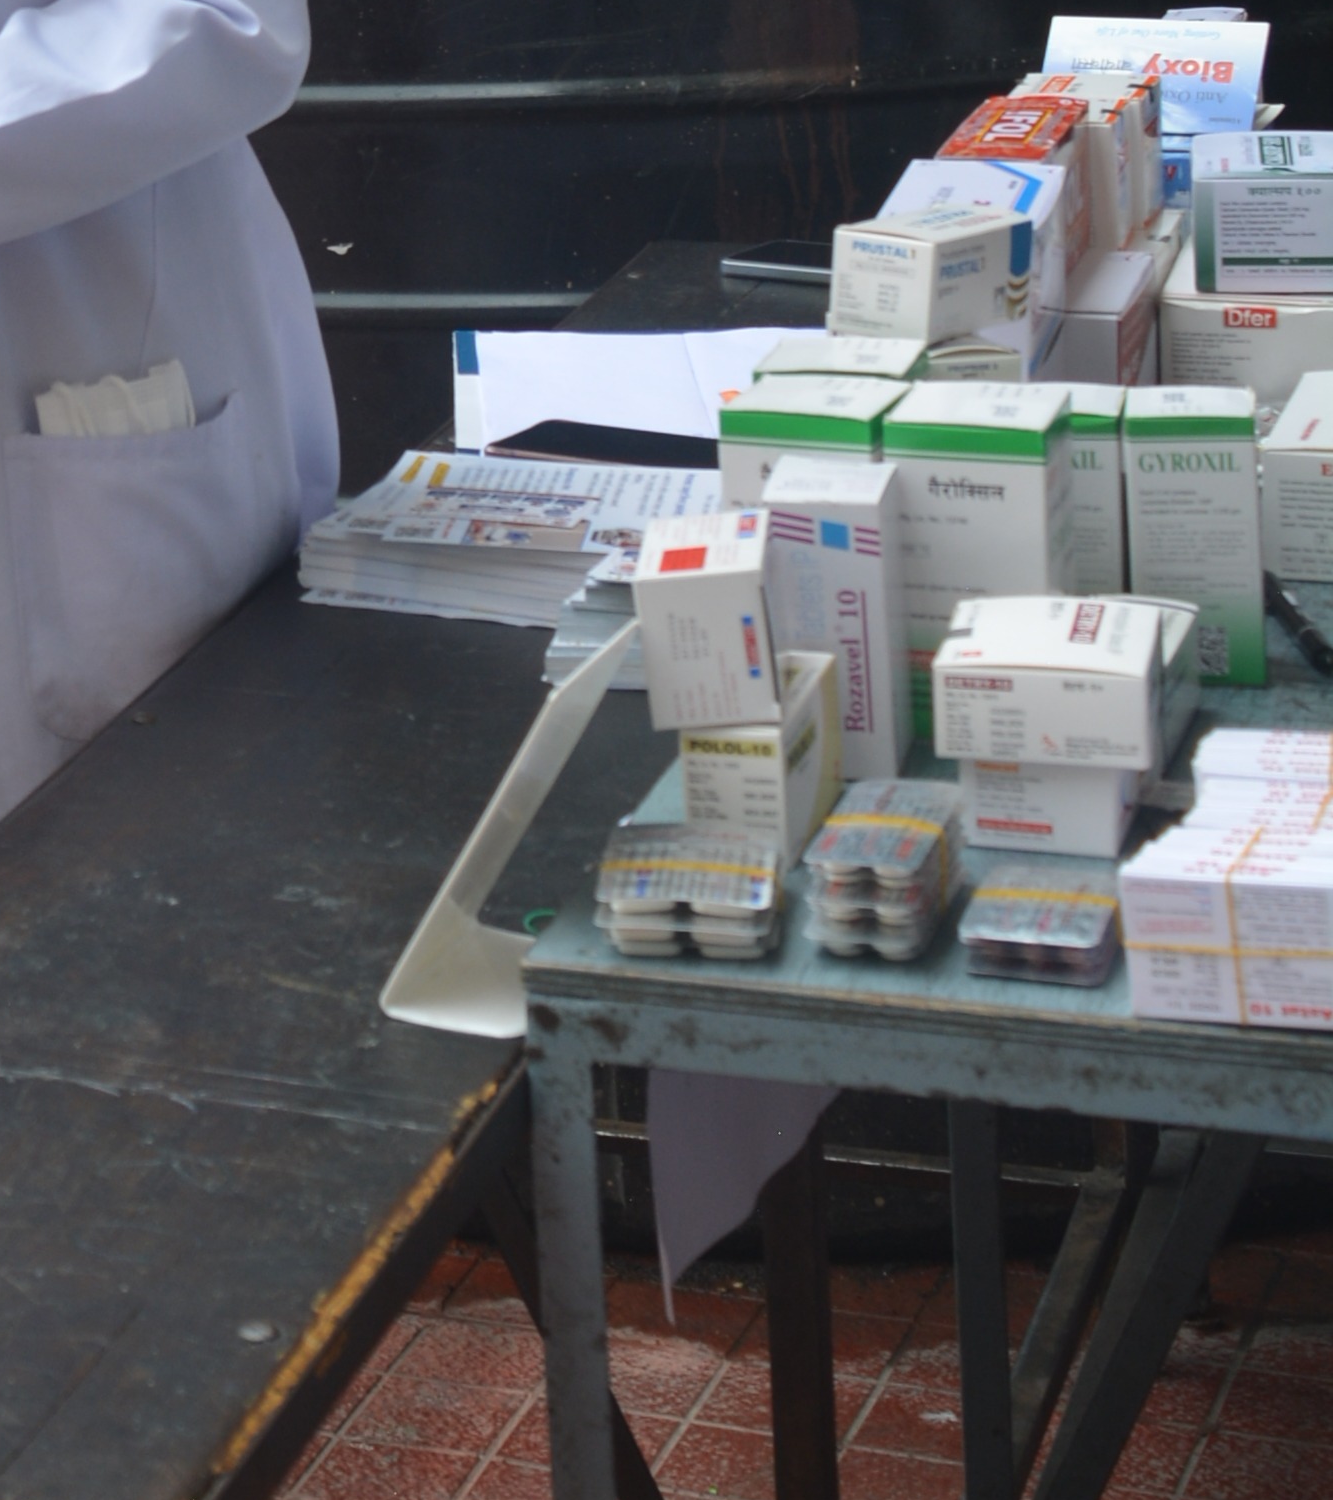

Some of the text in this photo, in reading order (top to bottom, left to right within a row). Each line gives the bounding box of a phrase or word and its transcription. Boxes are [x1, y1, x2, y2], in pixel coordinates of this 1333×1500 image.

[1142, 53, 1235, 84] Bioxy
[1227, 308, 1273, 327] Dfer
[1138, 450, 1241, 473] GYROXIL
[836, 589, 867, 733] Rozavel 10
[689, 739, 772, 757] POLOL-10
